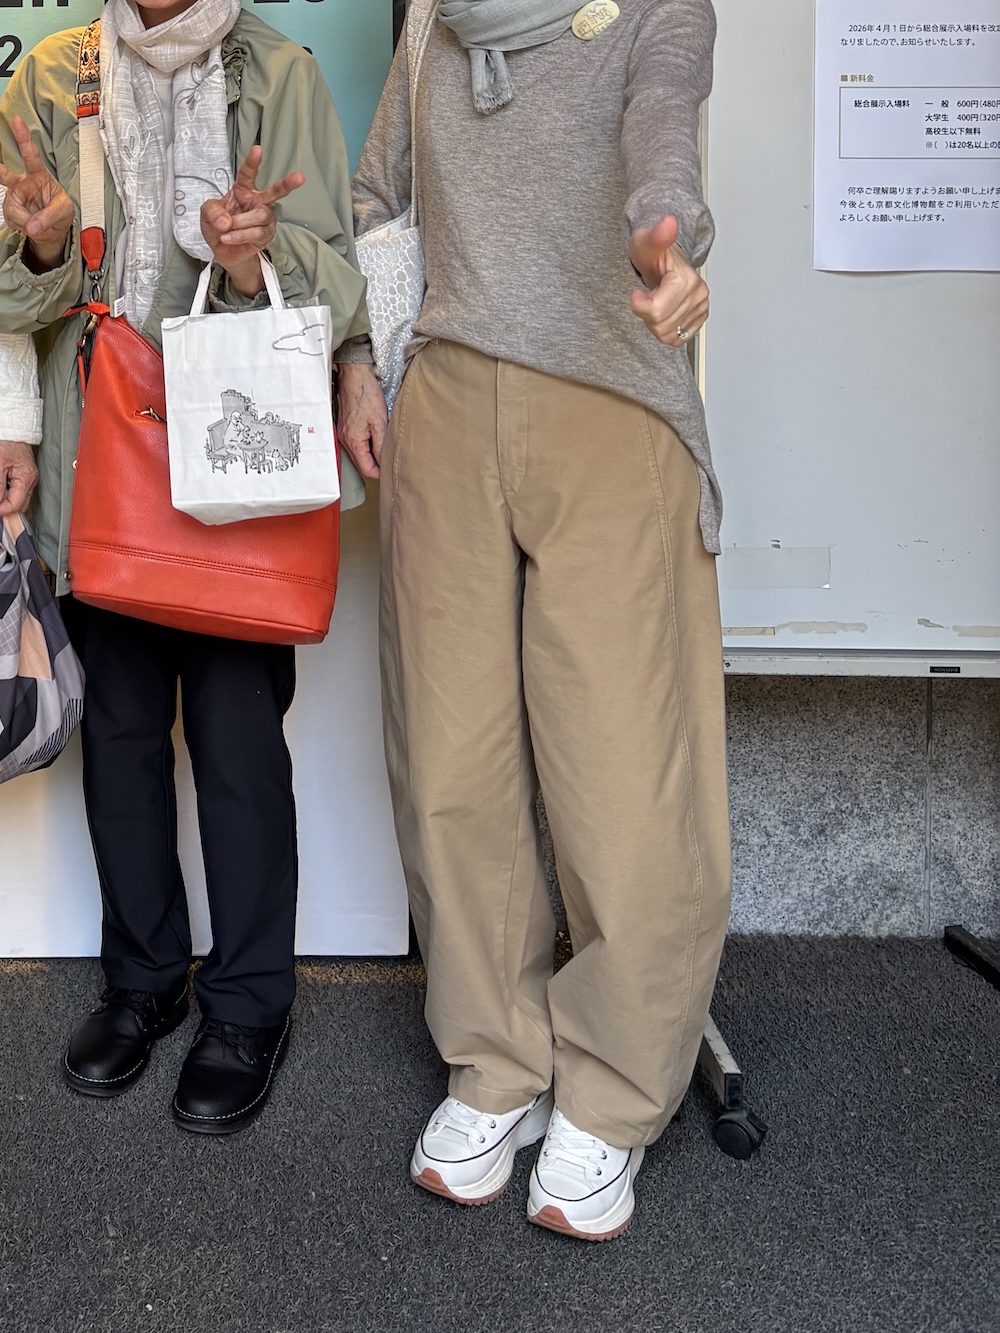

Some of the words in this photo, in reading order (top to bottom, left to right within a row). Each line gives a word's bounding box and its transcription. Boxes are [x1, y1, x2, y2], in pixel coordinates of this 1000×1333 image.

[925, 114, 949, 122] 大学生
[925, 127, 981, 136] 高校生以下無料
